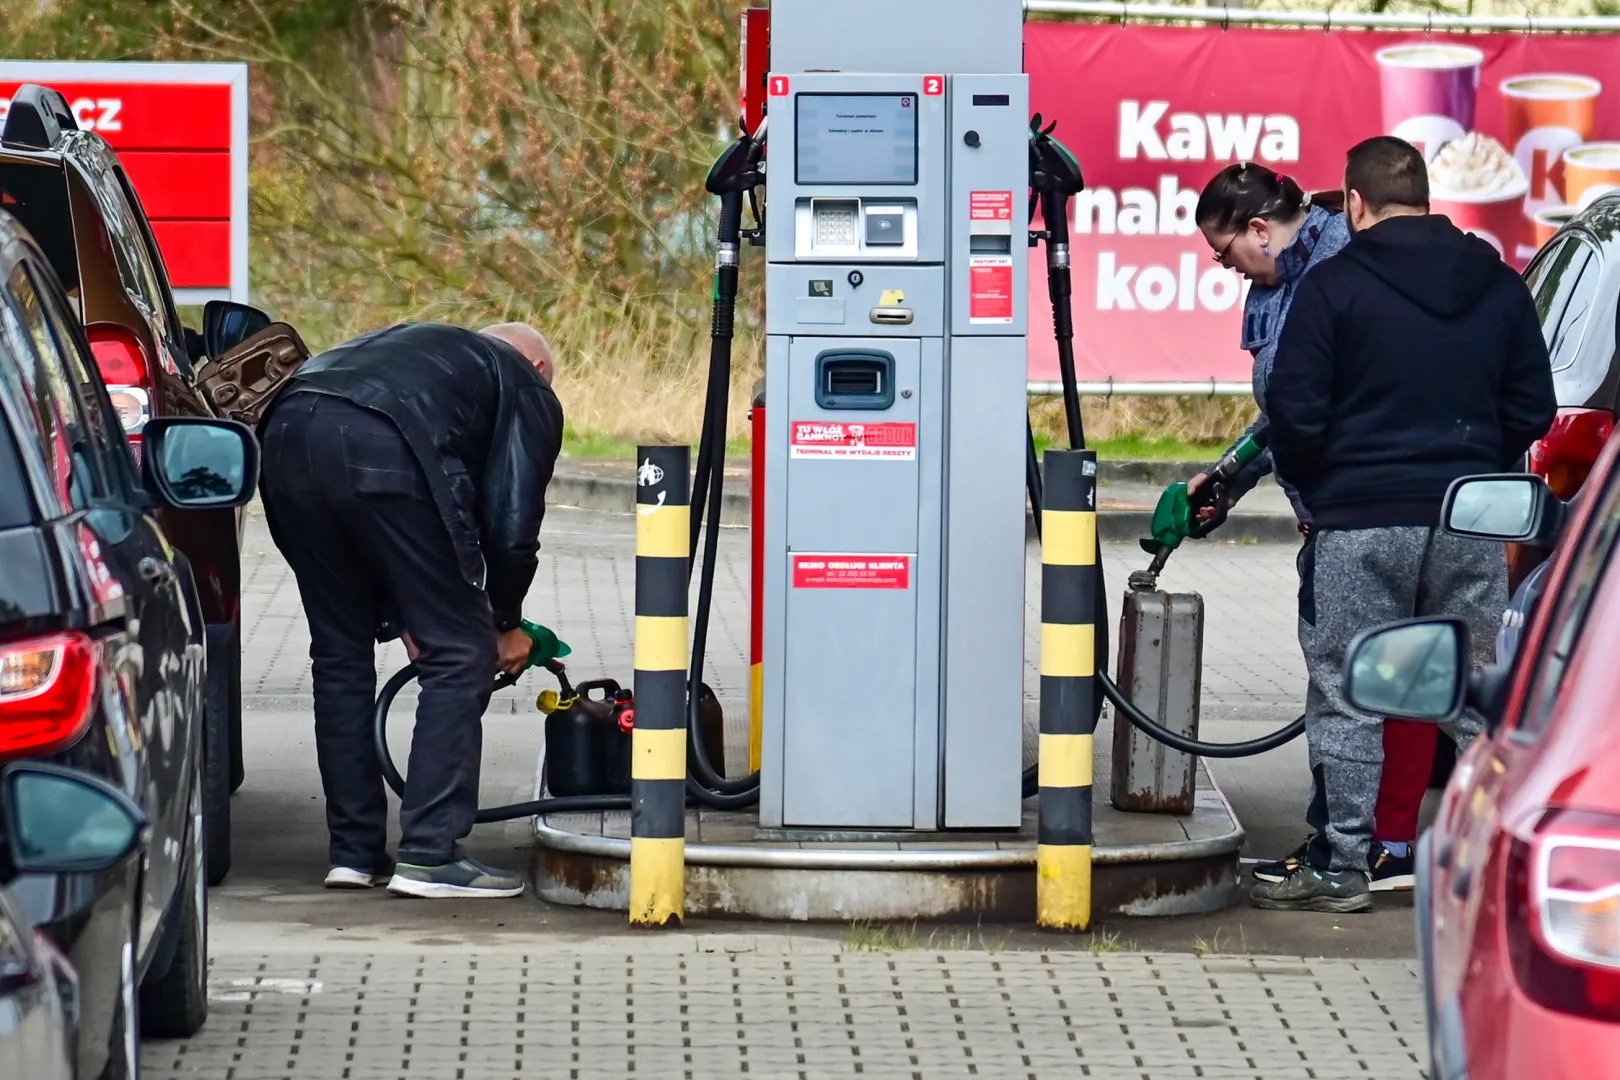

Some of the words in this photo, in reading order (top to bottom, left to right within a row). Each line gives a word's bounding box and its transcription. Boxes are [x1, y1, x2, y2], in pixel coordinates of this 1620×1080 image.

[774, 80, 783, 93] 1
[927, 79, 938, 93] 2
[70, 98, 122, 131] CZ
[1119, 100, 1300, 161] Kawa
[1074, 174, 1200, 236] nab
[796, 425, 811, 434] TU
[796, 433, 846, 441] BANKNOT
[798, 561, 825, 569] BIURO
[868, 562, 905, 570] KLIENTA
